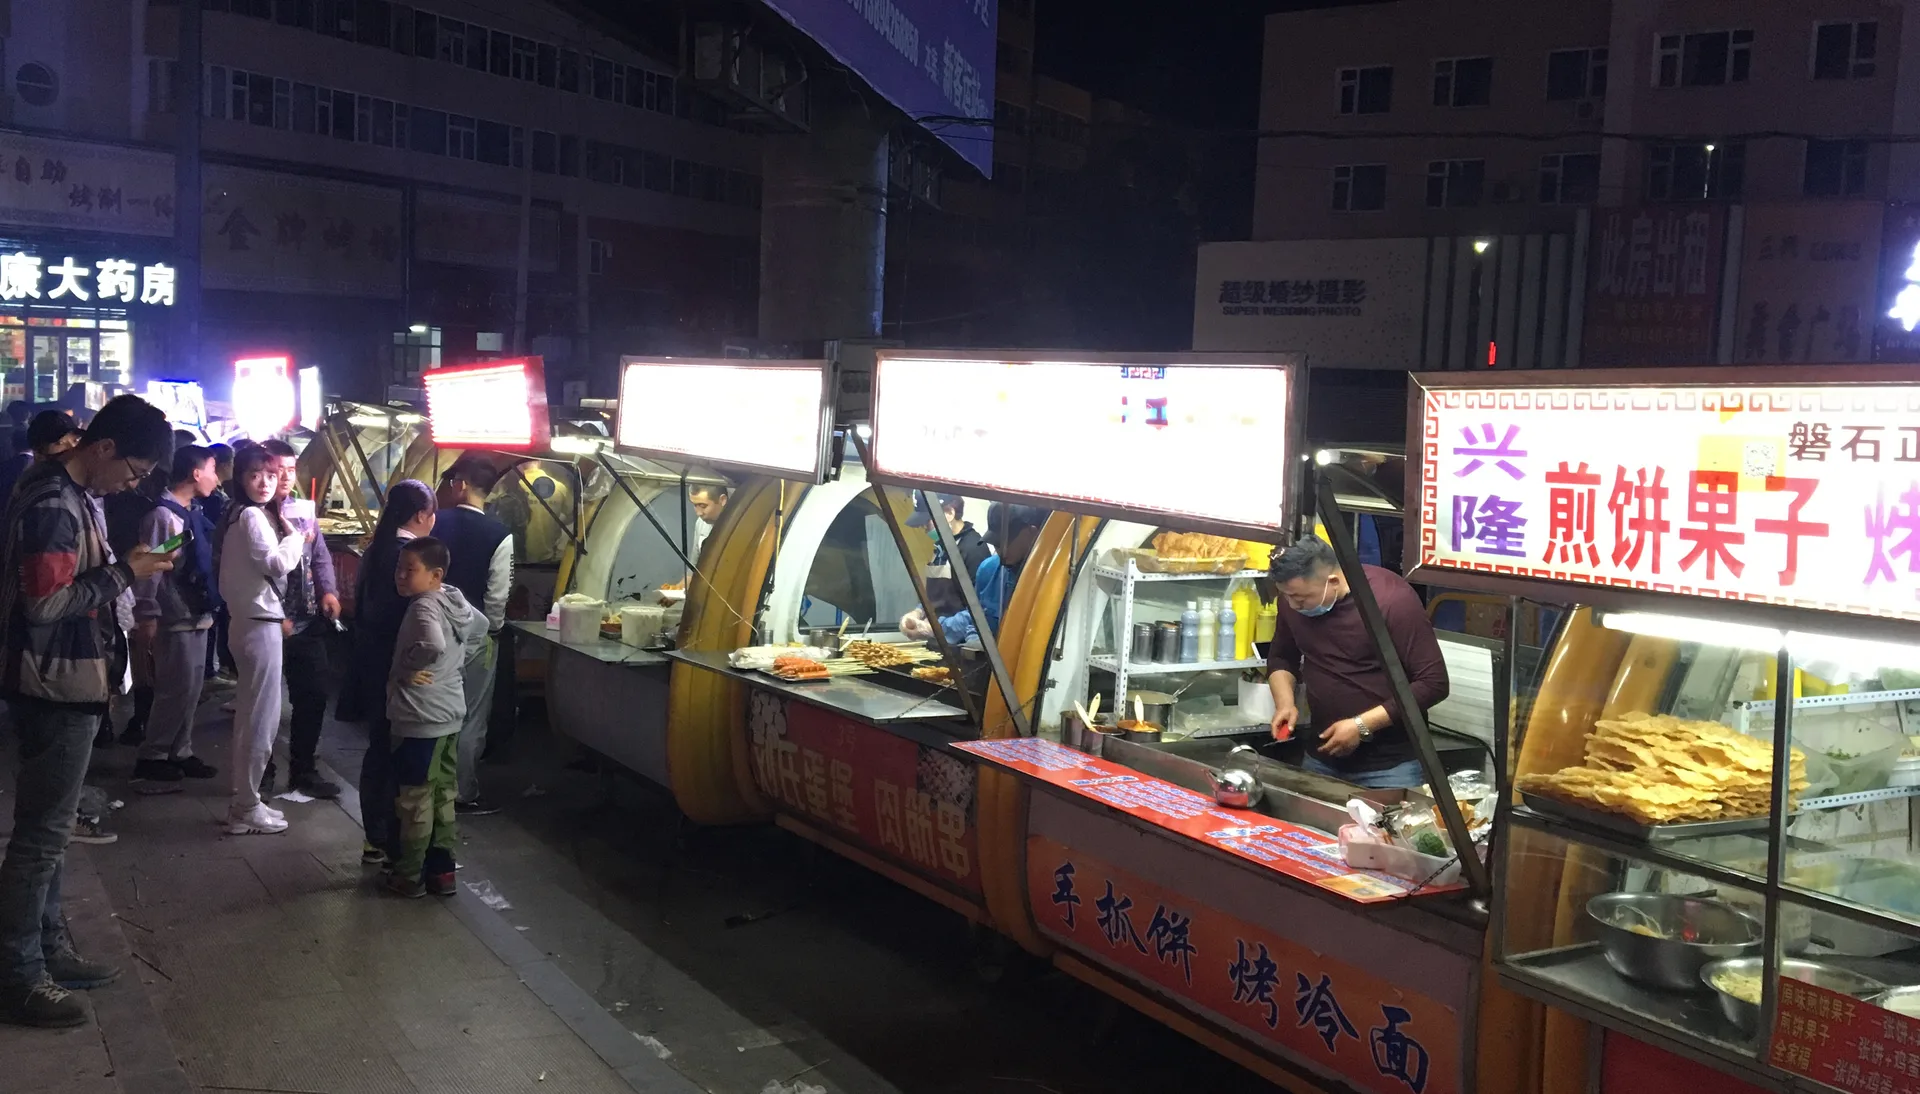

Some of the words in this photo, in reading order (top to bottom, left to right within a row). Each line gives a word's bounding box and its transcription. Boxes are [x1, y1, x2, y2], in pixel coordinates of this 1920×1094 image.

[0, 252, 176, 306] 康大药房
[1219, 279, 1367, 304] 超级婚纱摄影
[1597, 211, 1711, 297] 此房出租
[1222, 306, 1259, 316] SUPER
[1262, 306, 1316, 316] WEDDING
[1317, 306, 1362, 316] PHOTO
[1452, 423, 1528, 558] 兴隆
[1542, 460, 1830, 587] 煎饼果子
[1051, 858, 1198, 988] 手抓饼
[1228, 938, 1430, 1094] 烤冷面
